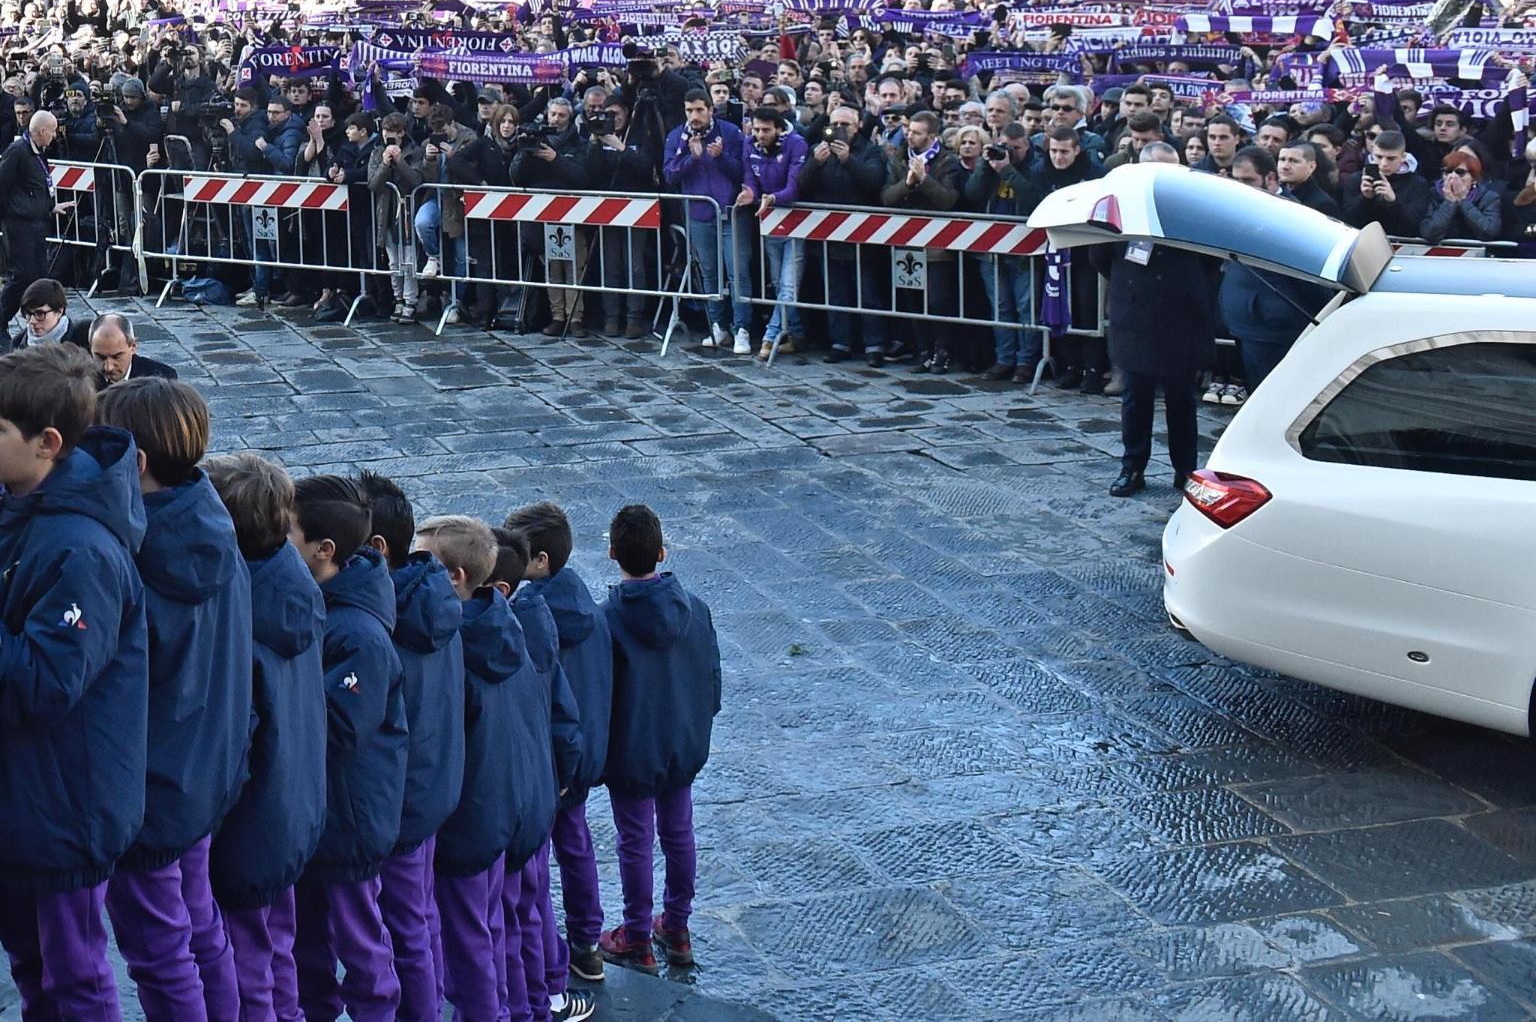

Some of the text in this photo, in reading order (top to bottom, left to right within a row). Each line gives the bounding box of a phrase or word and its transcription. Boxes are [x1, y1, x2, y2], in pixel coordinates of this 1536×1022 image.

[1371, 4, 1431, 17] FIORENTIN
[1023, 14, 1113, 25] FIORENTINA
[395, 32, 497, 52] FIORENTINA
[571, 46, 600, 63] WALK
[448, 61, 533, 77] FIORENTINA
[1251, 89, 1324, 100] FIORENTINA
[551, 248, 570, 258] SaS
[897, 275, 922, 287] SaS
